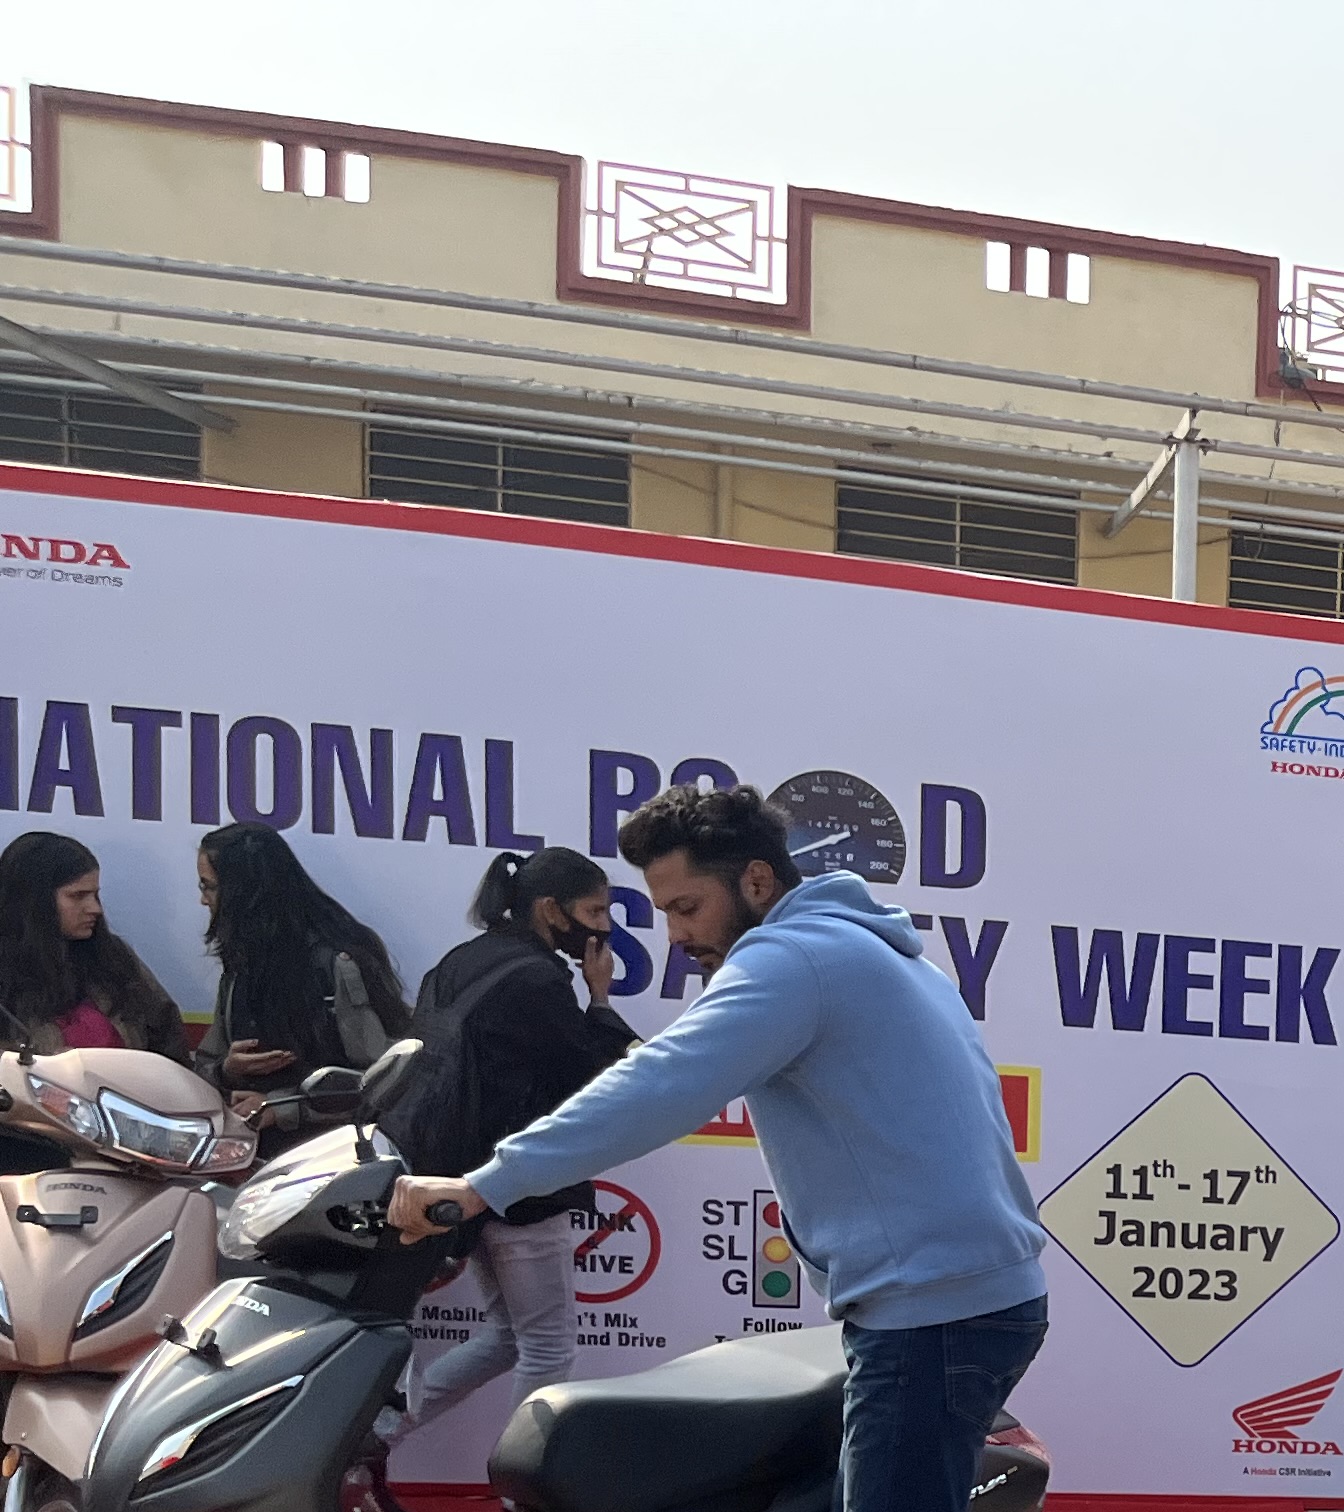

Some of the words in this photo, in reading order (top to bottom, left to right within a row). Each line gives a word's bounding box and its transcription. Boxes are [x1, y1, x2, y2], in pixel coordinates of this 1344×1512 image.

[51, 569, 124, 587] Dreams
[0, 696, 546, 851] ATIONAL
[869, 861, 889, 870] 200
[1050, 925, 1341, 1046] WEEK
[568, 1211, 637, 1233] RINK
[1094, 1210, 1284, 1261] January
[573, 1254, 635, 1275] RIVE
[1131, 1266, 1239, 1301] 2023
[604, 1313, 639, 1329] Mix
[742, 1317, 803, 1334] Follow
[577, 1332, 611, 1347] and
[617, 1332, 667, 1348] Drive
[1231, 1439, 1344, 1456] HONDA
[1278, 1467, 1297, 1477] CSR
[1298, 1468, 1332, 1477] Initiative
